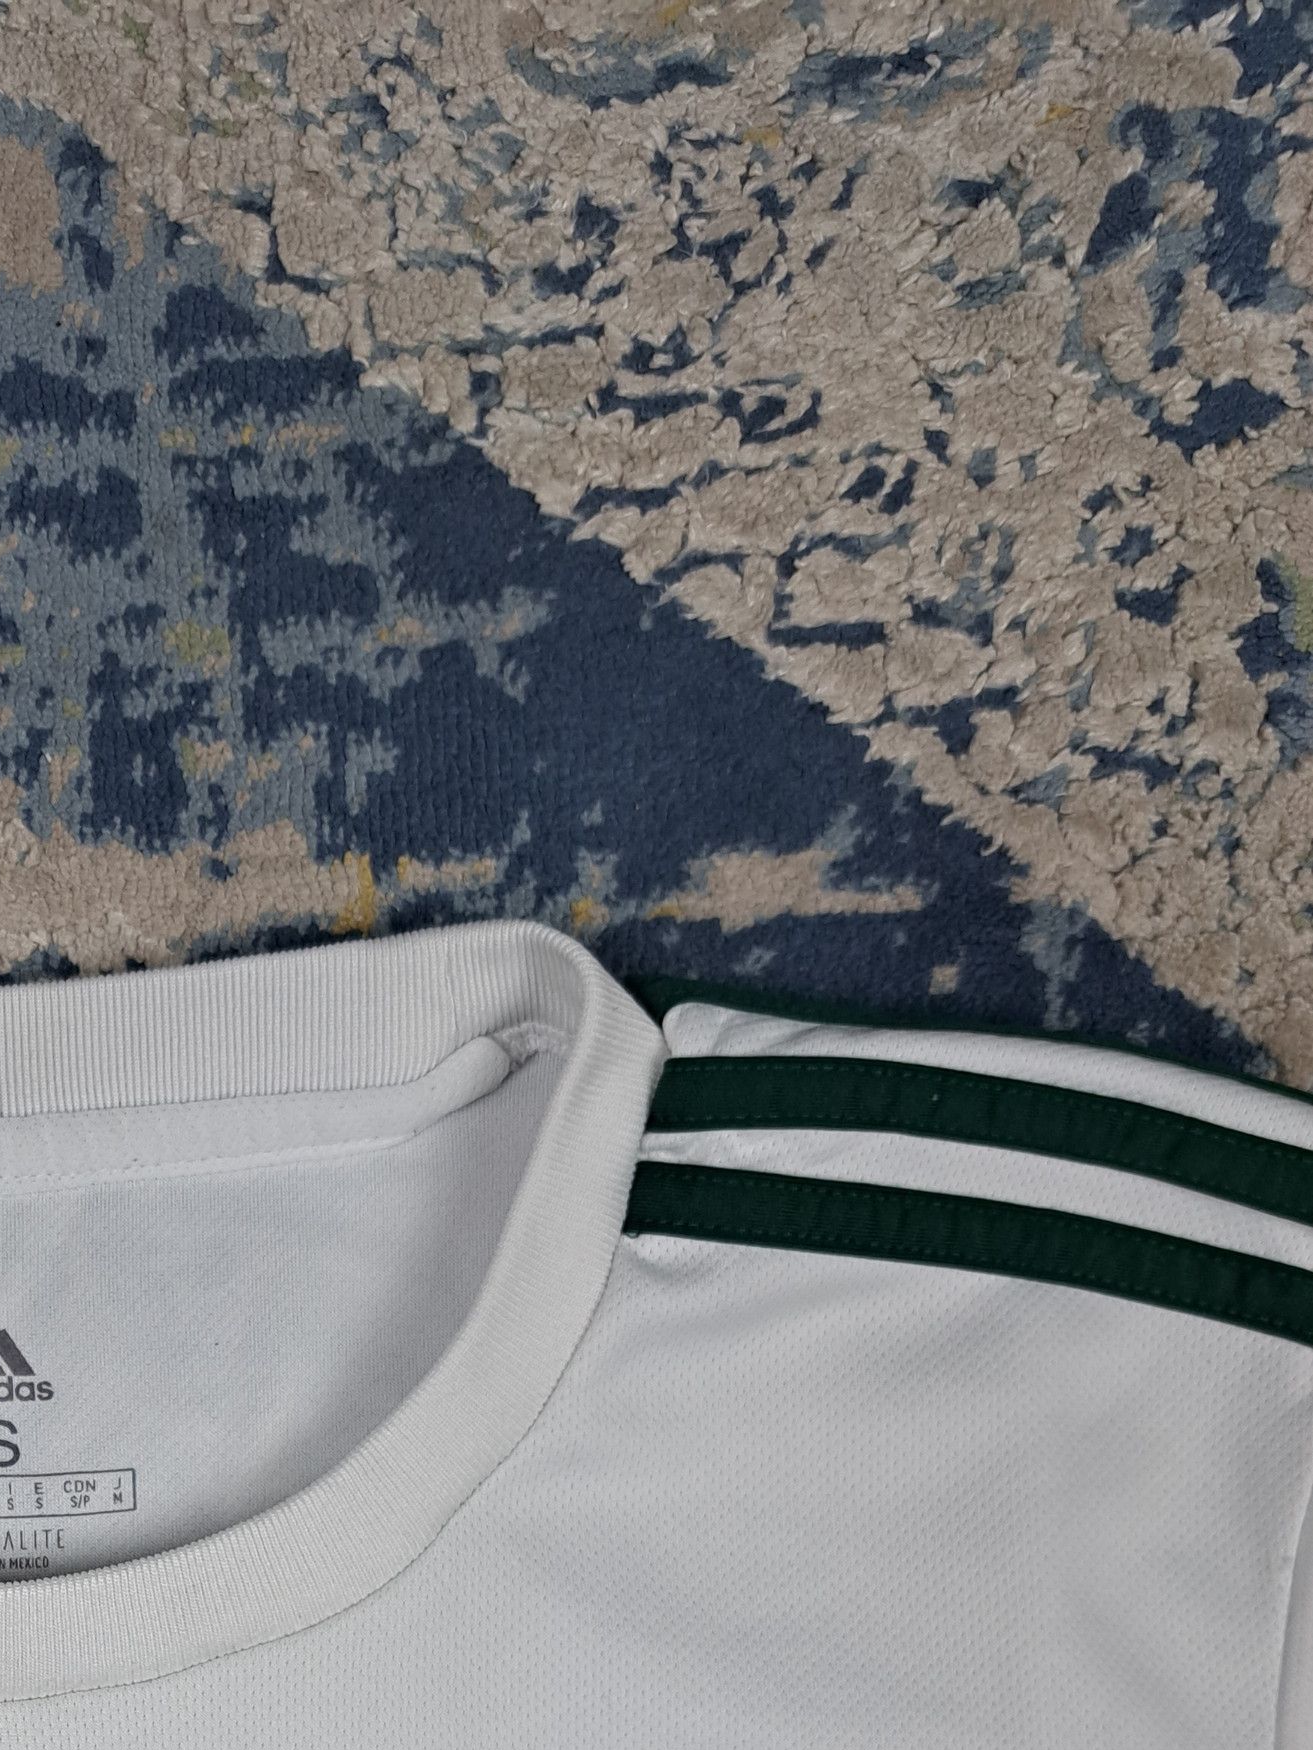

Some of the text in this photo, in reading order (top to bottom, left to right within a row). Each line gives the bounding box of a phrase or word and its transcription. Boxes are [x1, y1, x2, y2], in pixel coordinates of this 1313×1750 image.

[34, 1482, 44, 1495] E
[63, 1479, 97, 1493] CDN
[113, 1476, 122, 1490] J
[7, 1498, 15, 1511] S
[35, 1498, 44, 1510] S
[70, 1494, 91, 1509] S/P
[113, 1491, 123, 1504] M
[9, 1555, 50, 1570] MEXICO
